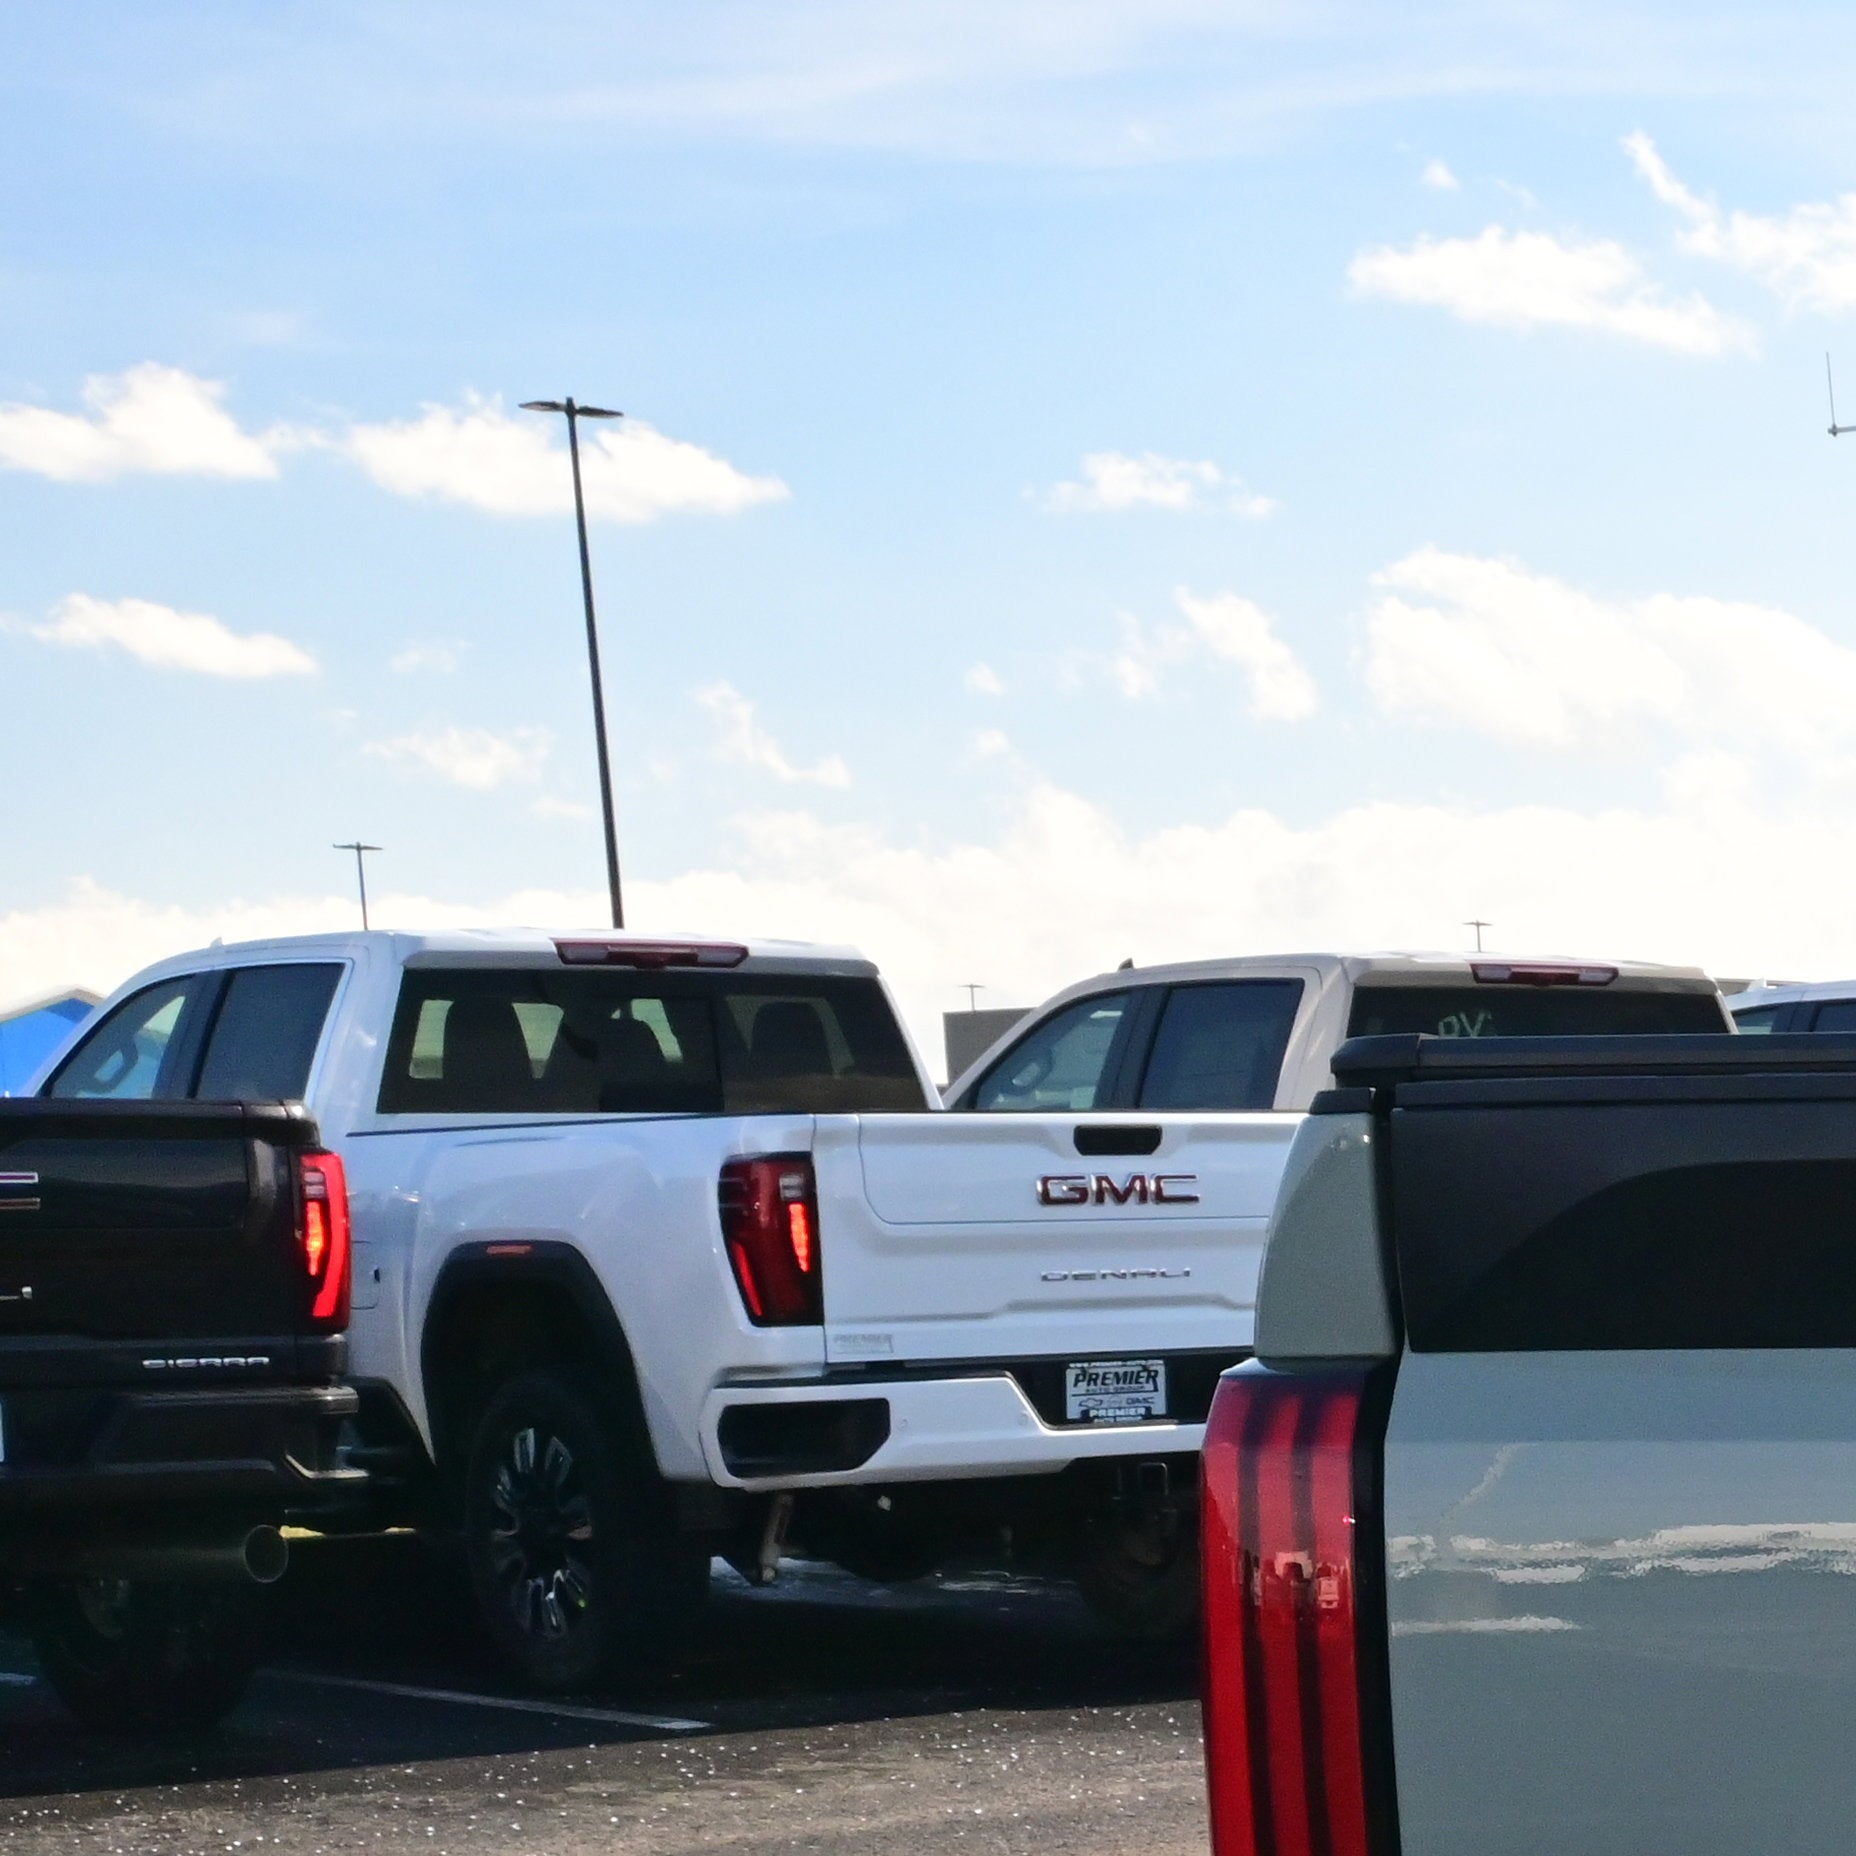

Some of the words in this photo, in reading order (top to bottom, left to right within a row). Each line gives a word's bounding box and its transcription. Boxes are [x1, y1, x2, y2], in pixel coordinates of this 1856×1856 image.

[1036, 1172, 1200, 1206] GMC
[1041, 1267, 1191, 1282] DENALI
[1073, 1368, 1159, 1390] PREMIER
[1089, 1407, 1146, 1418] PREMIER
